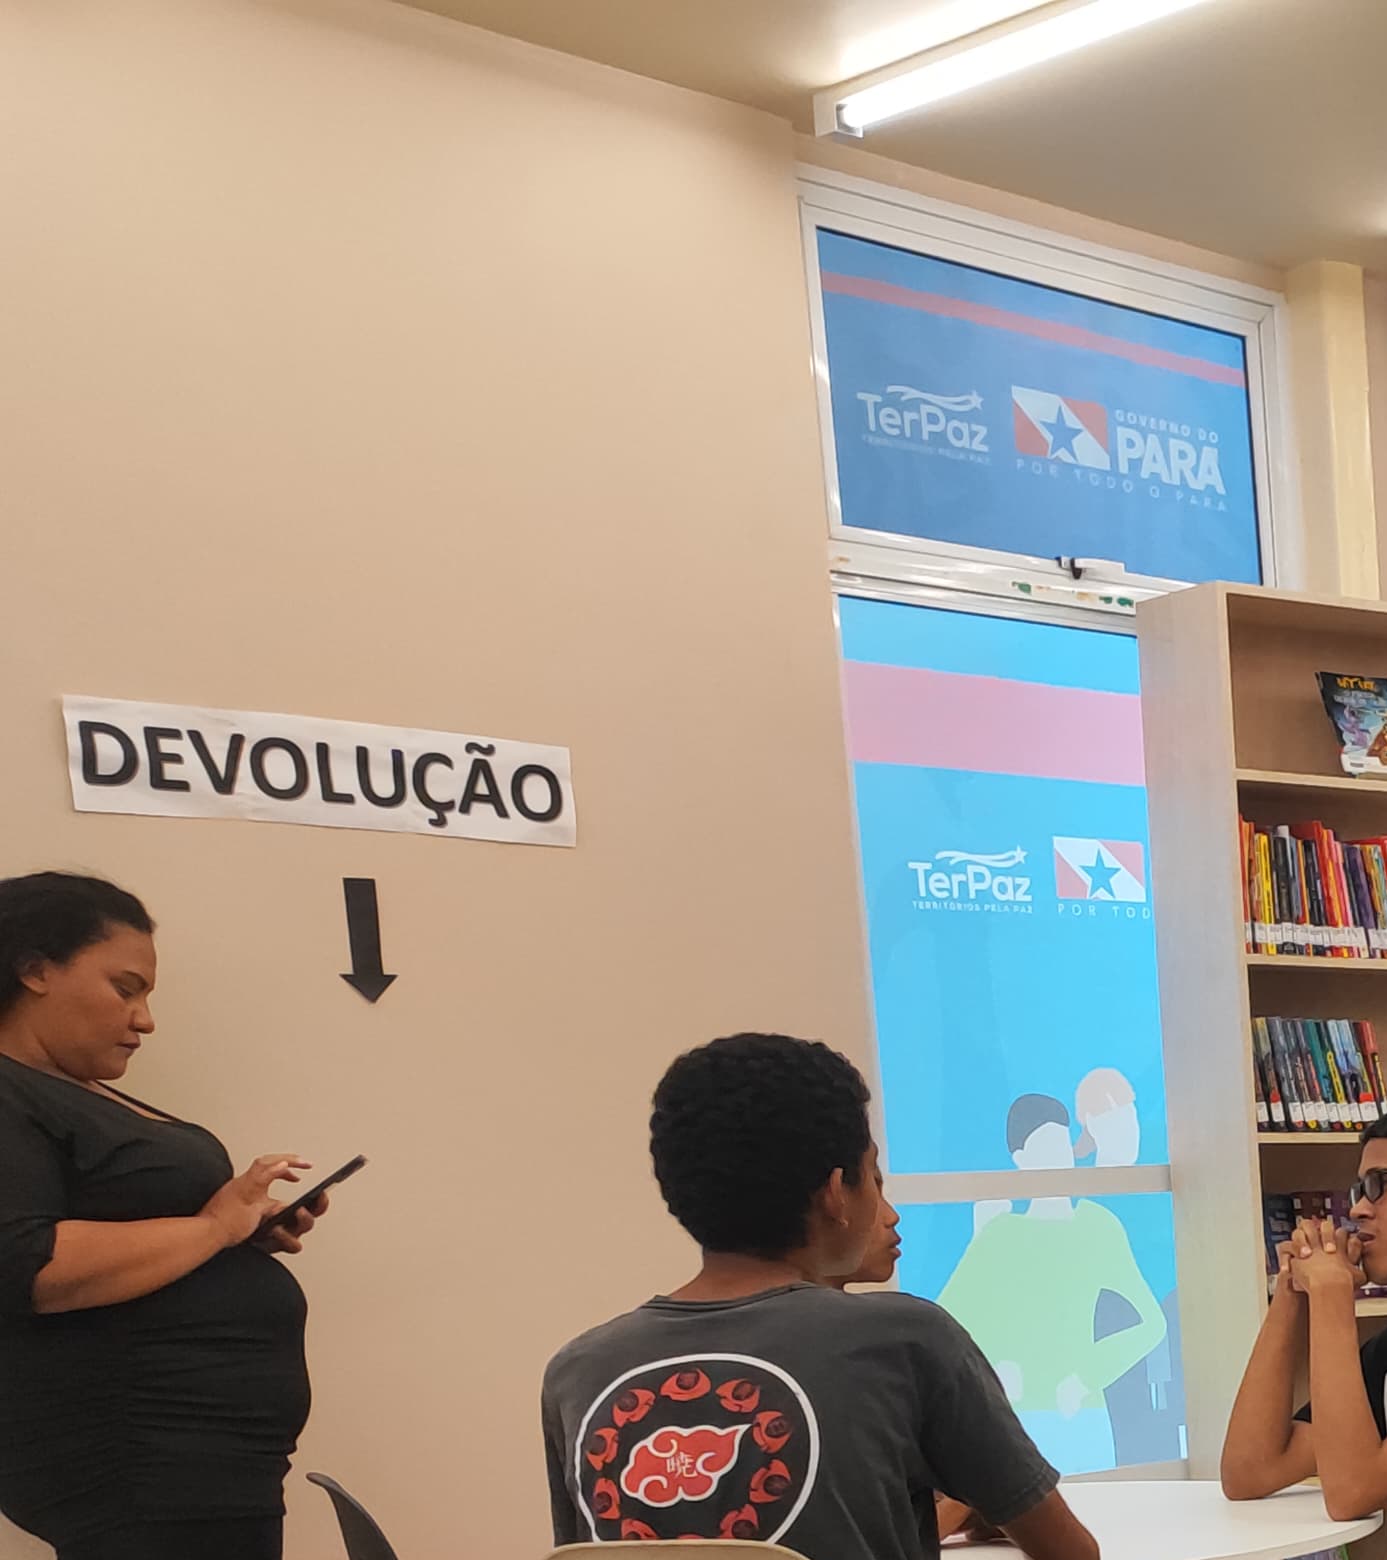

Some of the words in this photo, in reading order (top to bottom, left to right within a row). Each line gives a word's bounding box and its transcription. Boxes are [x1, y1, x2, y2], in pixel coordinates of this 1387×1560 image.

[857, 390, 990, 452] TerPaz
[1115, 409, 1191, 438] GOVERNO
[1197, 428, 1219, 444] DO
[1016, 458, 1059, 477] POR
[1074, 468, 1134, 494] TODO
[78, 719, 564, 828] DEVOLUÇÃO
[907, 862, 1033, 902] TerPaz
[1058, 903, 1097, 917] POR
